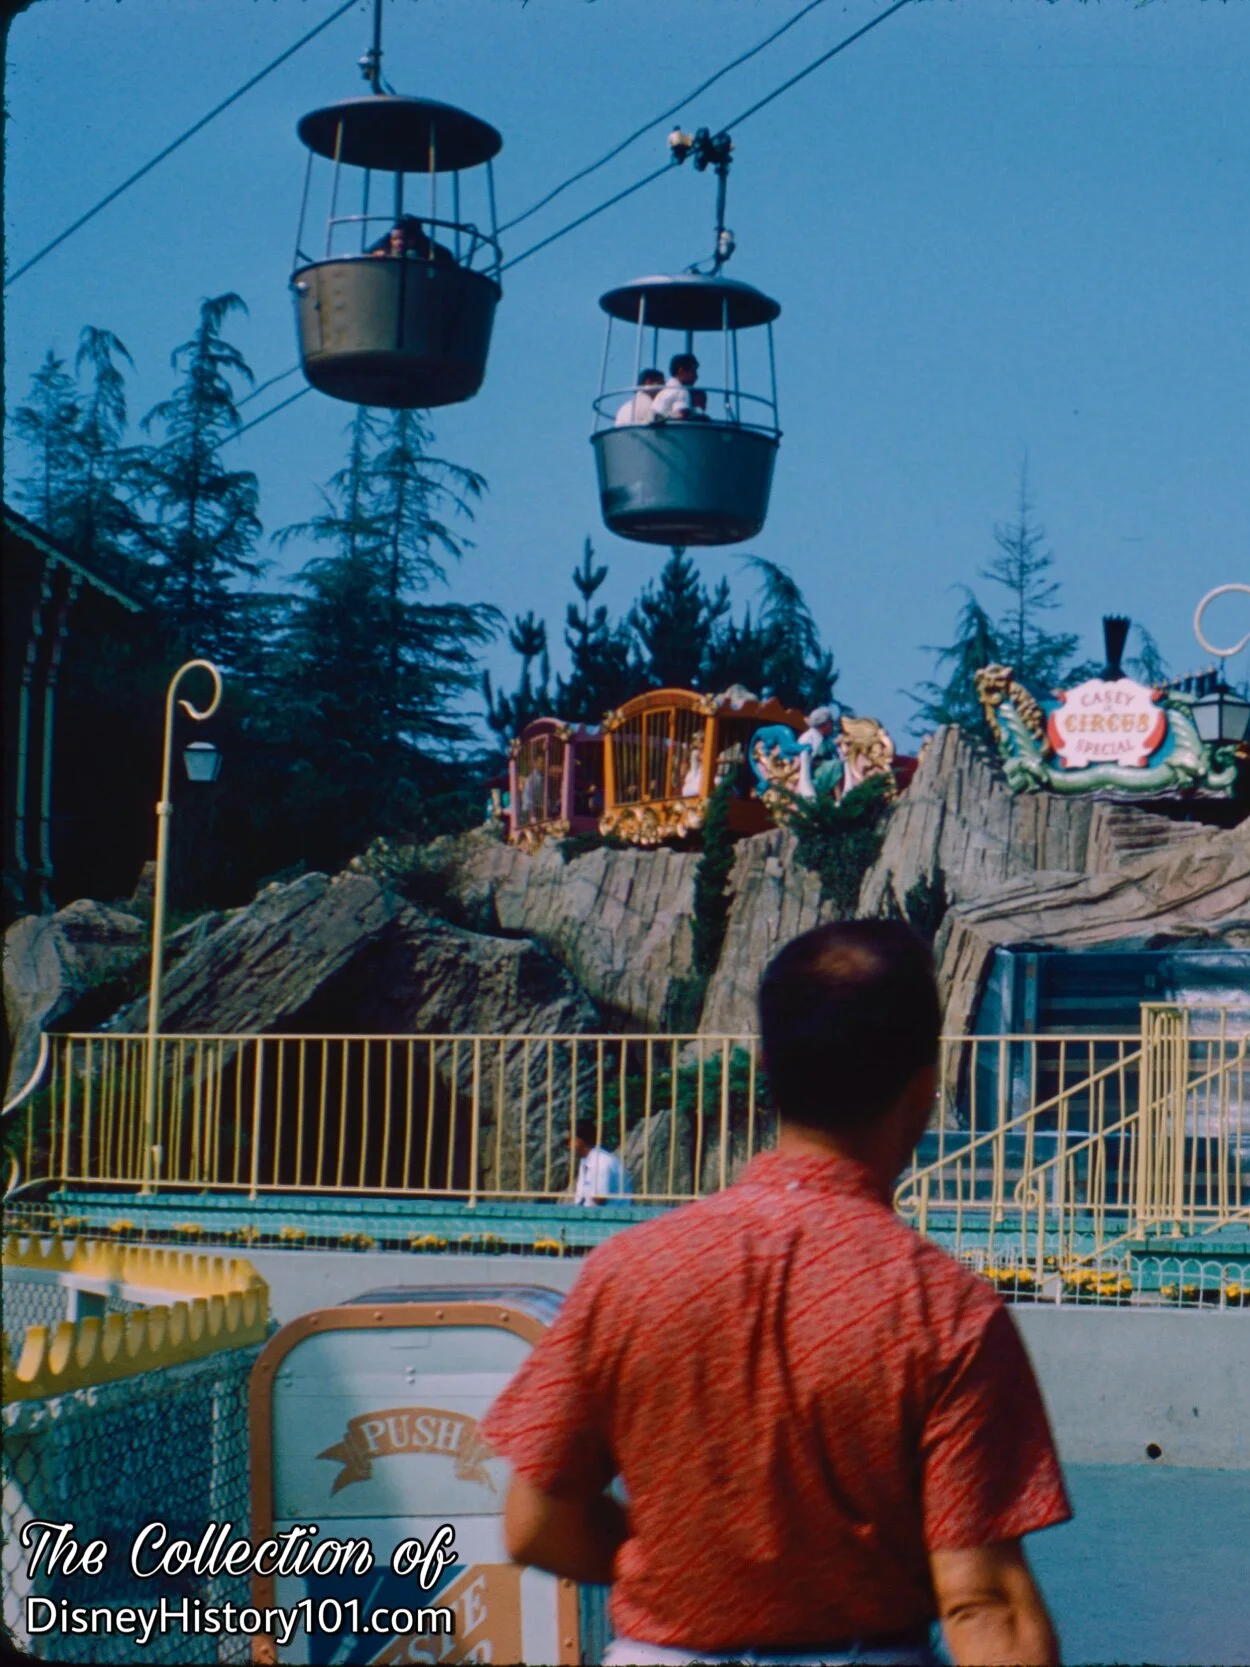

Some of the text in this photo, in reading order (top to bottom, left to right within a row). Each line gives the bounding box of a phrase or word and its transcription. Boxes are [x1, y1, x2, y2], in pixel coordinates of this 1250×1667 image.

[1081, 690, 1135, 707] CASEY
[1064, 713, 1150, 733] CIRCUS
[1076, 739, 1135, 755] SPECIAL
[361, 1414, 464, 1452] PUSH
